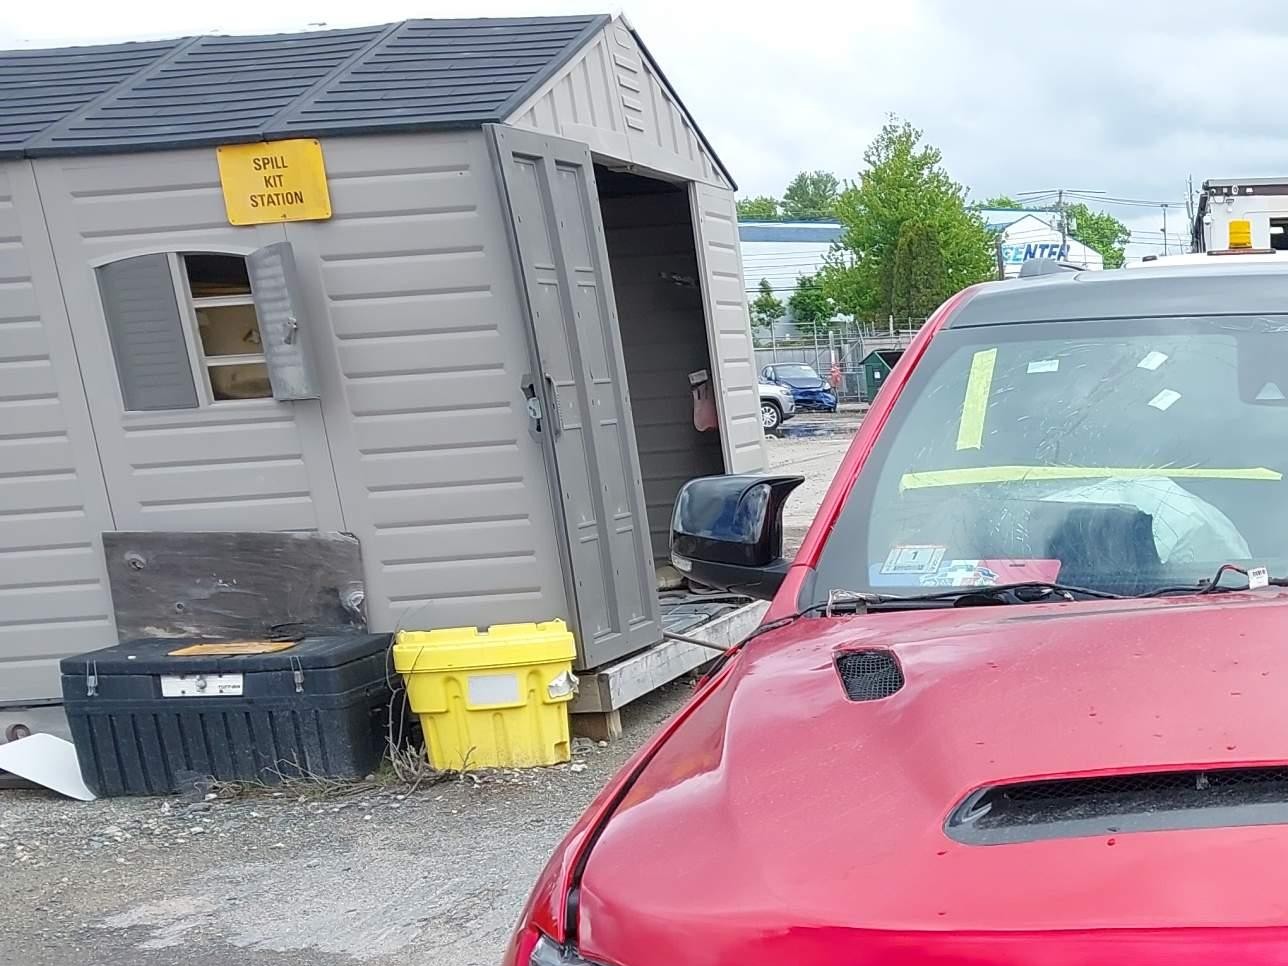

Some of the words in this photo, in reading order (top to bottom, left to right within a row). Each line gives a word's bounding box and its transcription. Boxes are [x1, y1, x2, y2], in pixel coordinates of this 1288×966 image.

[252, 156, 288, 171] SPILL
[263, 174, 284, 188] KIT
[249, 191, 304, 208] STATION
